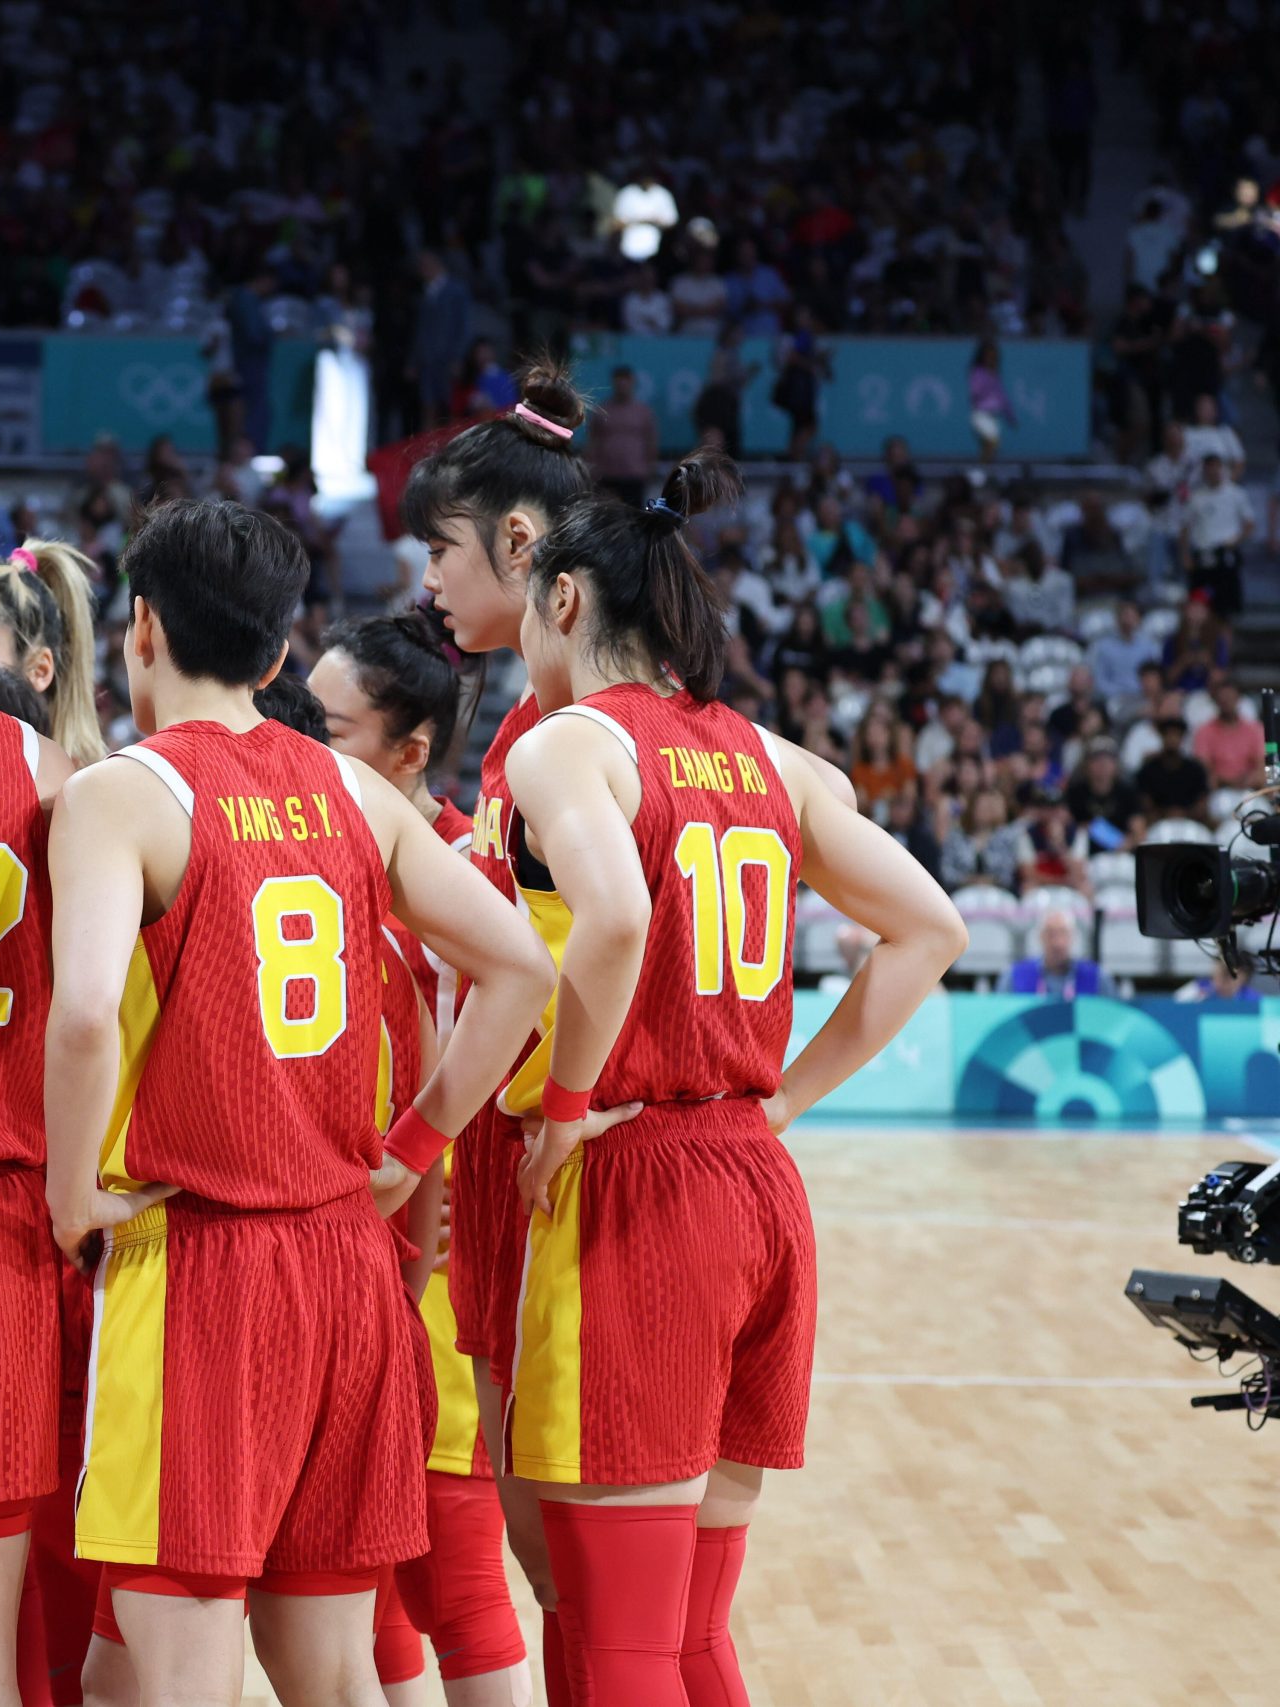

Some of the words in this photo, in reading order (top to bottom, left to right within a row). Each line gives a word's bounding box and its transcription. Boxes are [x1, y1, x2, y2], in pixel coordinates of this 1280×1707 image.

[217, 795, 282, 842] YANG
[285, 793, 342, 841] S.Y.
[659, 746, 734, 794] ZHANG
[736, 751, 767, 796] RU
[251, 874, 346, 1059] 8
[674, 821, 791, 1002] 10
